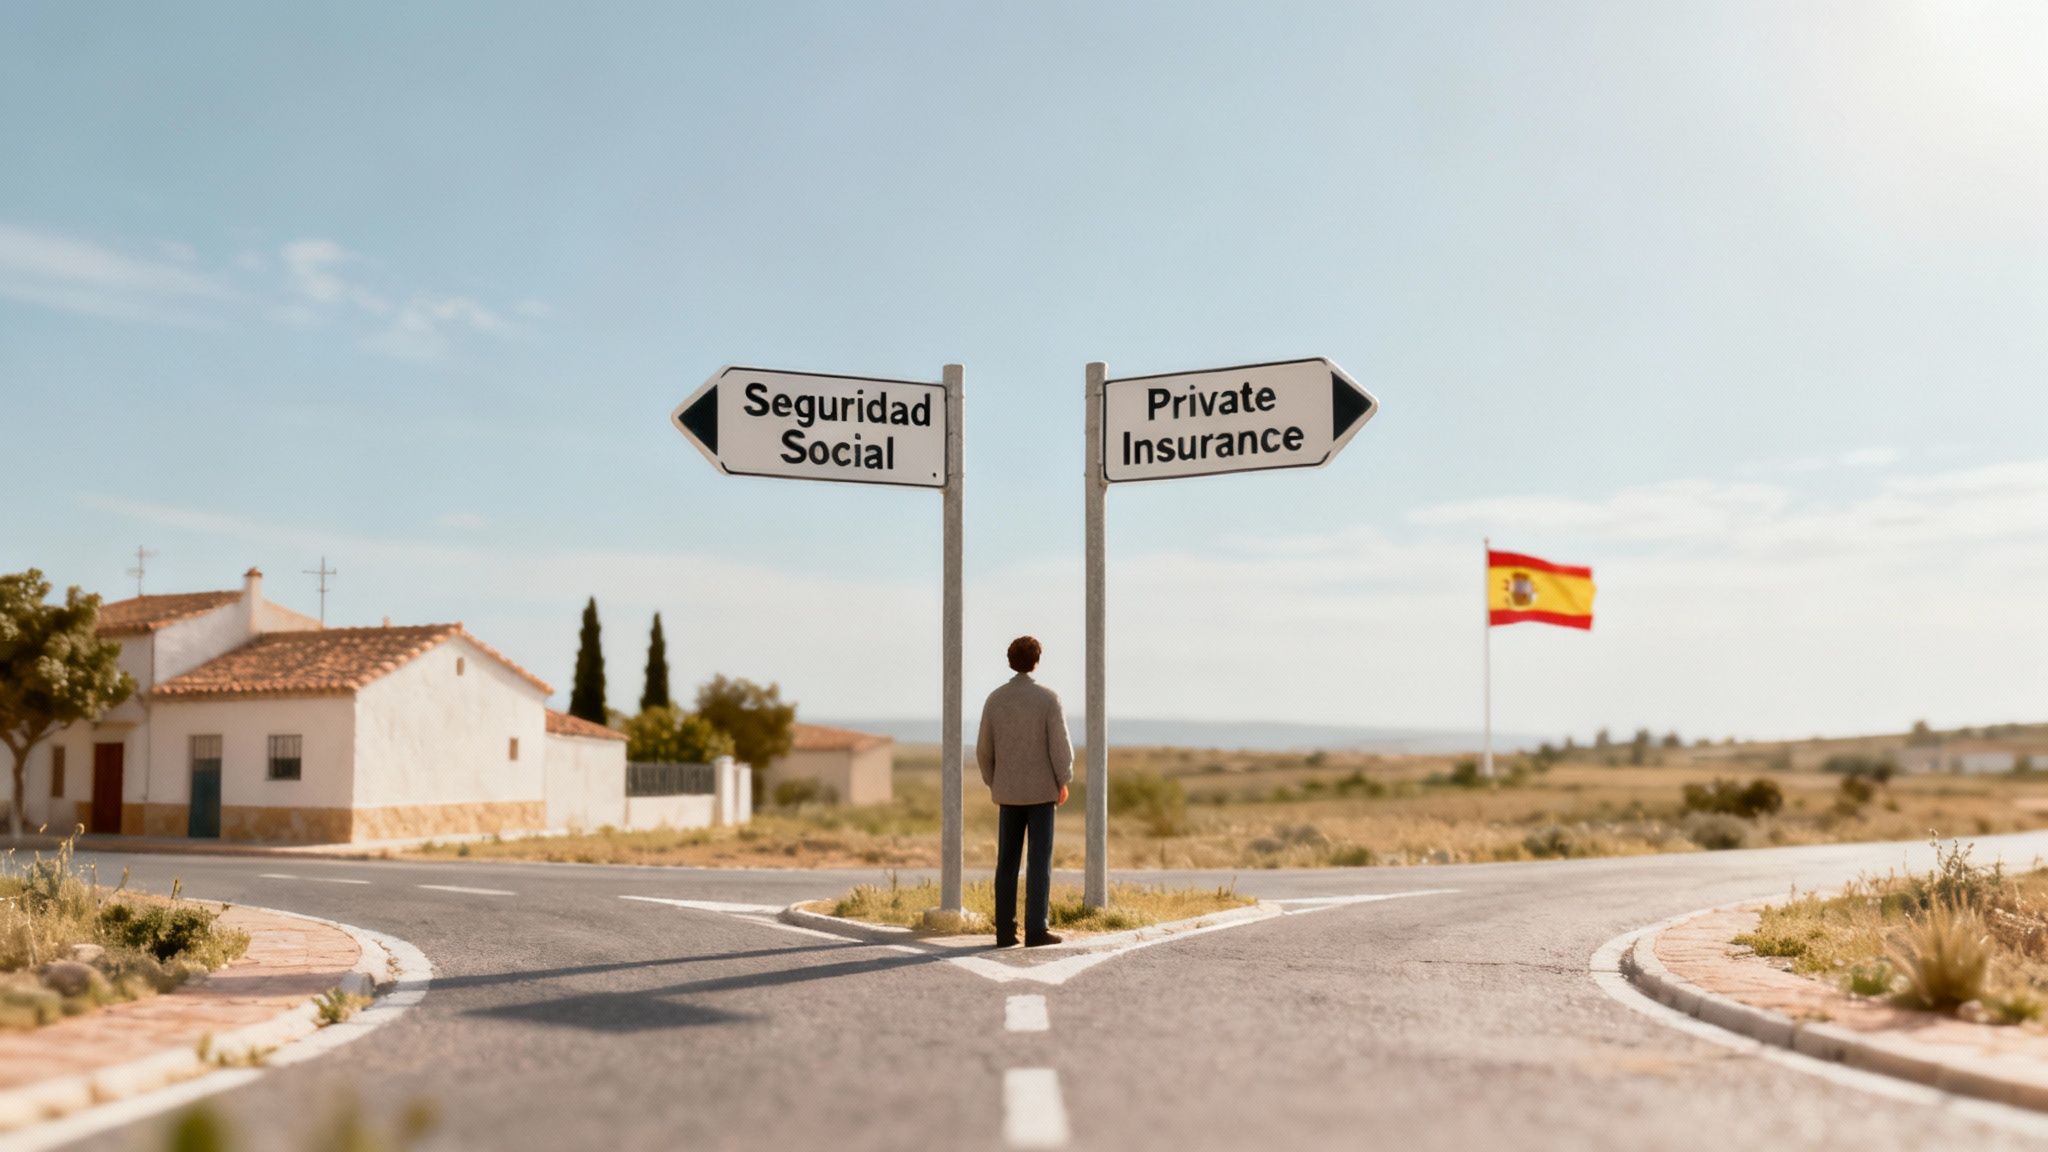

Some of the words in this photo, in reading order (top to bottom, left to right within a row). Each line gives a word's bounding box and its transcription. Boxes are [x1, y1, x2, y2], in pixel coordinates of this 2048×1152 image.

[744, 382, 931, 429] Seguridad
[1147, 381, 1276, 421] Private
[780, 429, 894, 470] Social
[1123, 425, 1305, 466] Insurance
